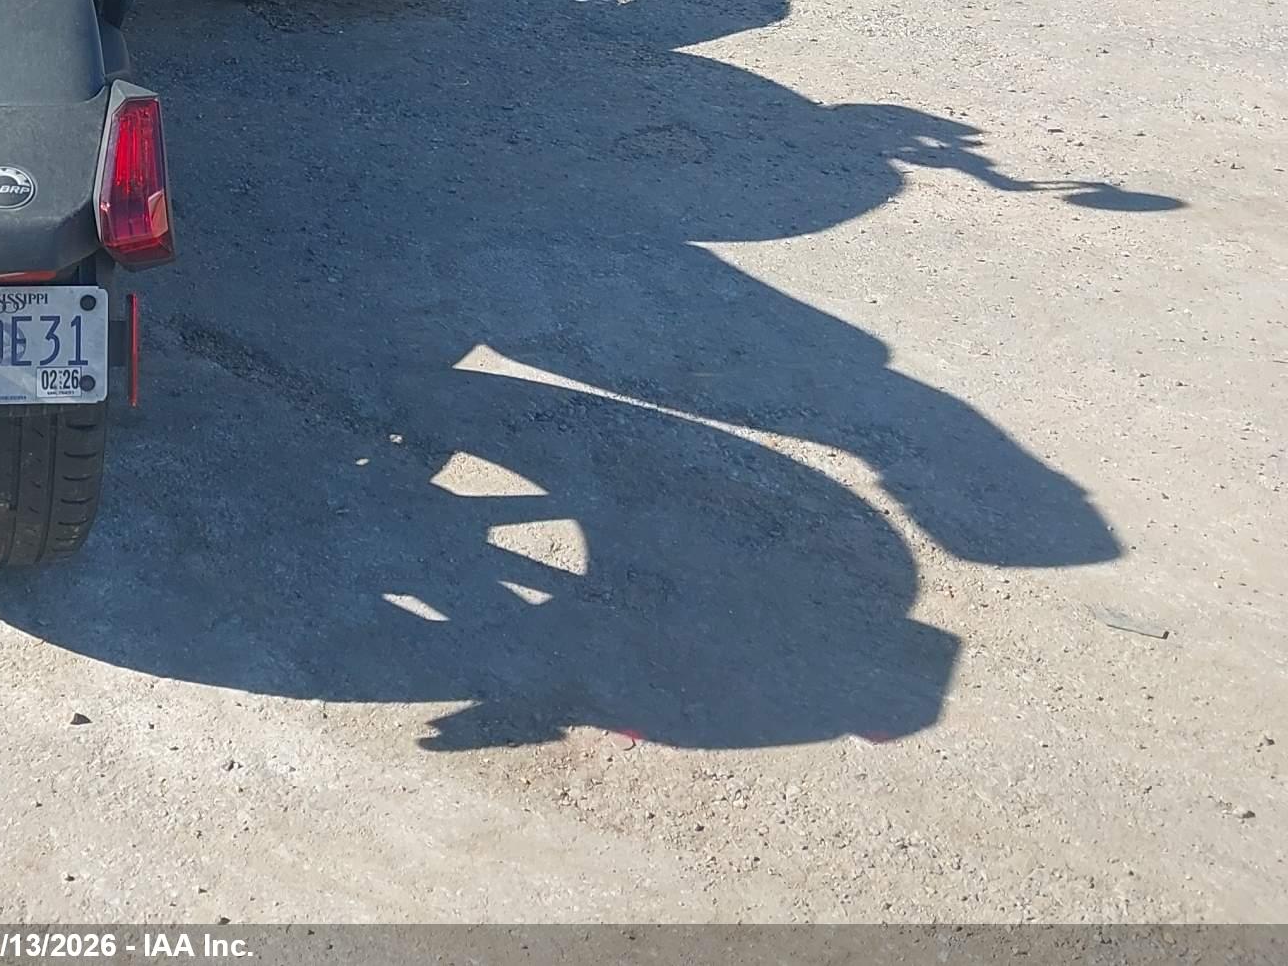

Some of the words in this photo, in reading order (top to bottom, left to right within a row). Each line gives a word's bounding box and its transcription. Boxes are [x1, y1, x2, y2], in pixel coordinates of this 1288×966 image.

[0, 185, 30, 194] BRP
[41, 370, 57, 390] 02
[63, 369, 79, 389] 26
